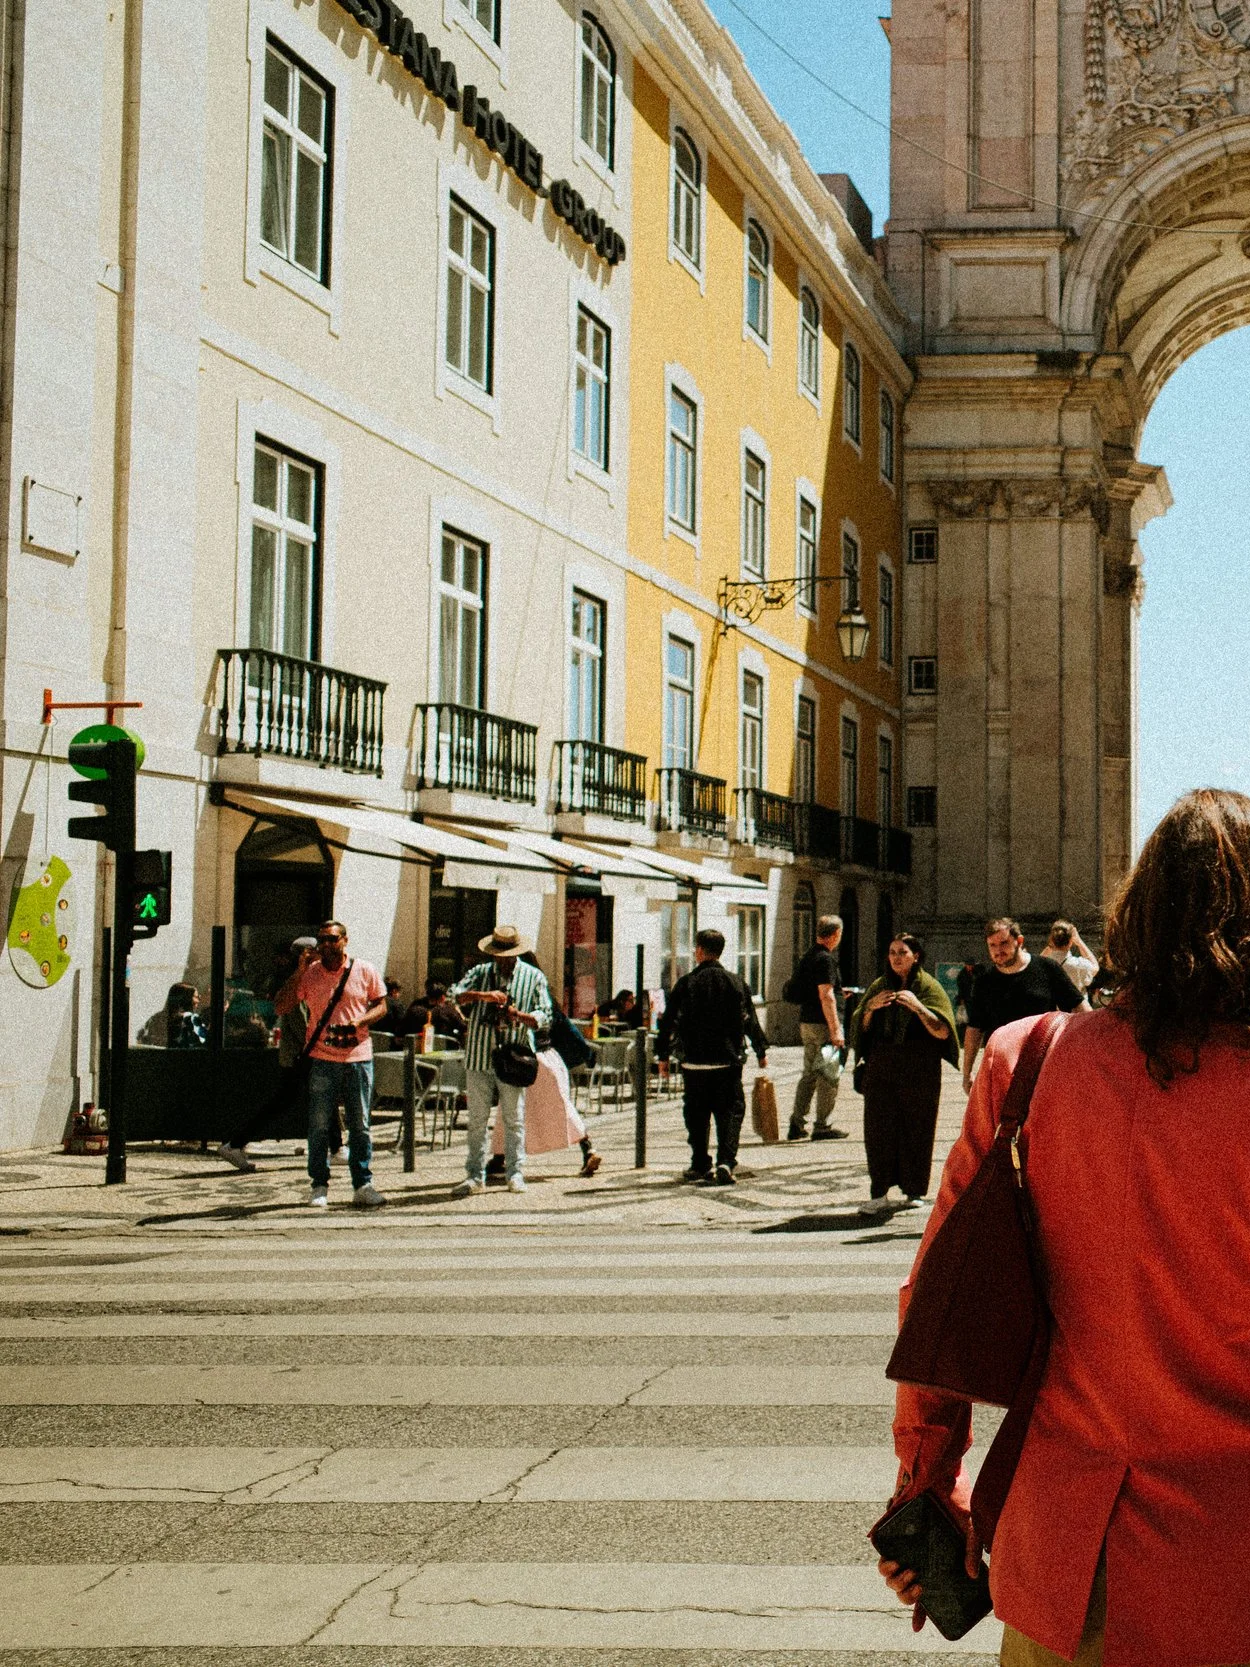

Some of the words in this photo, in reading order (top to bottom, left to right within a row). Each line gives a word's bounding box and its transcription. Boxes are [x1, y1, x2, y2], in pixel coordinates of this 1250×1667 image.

[335, 0, 460, 112] STANA
[462, 84, 549, 198] HOTEL
[550, 178, 627, 267] GROUP
